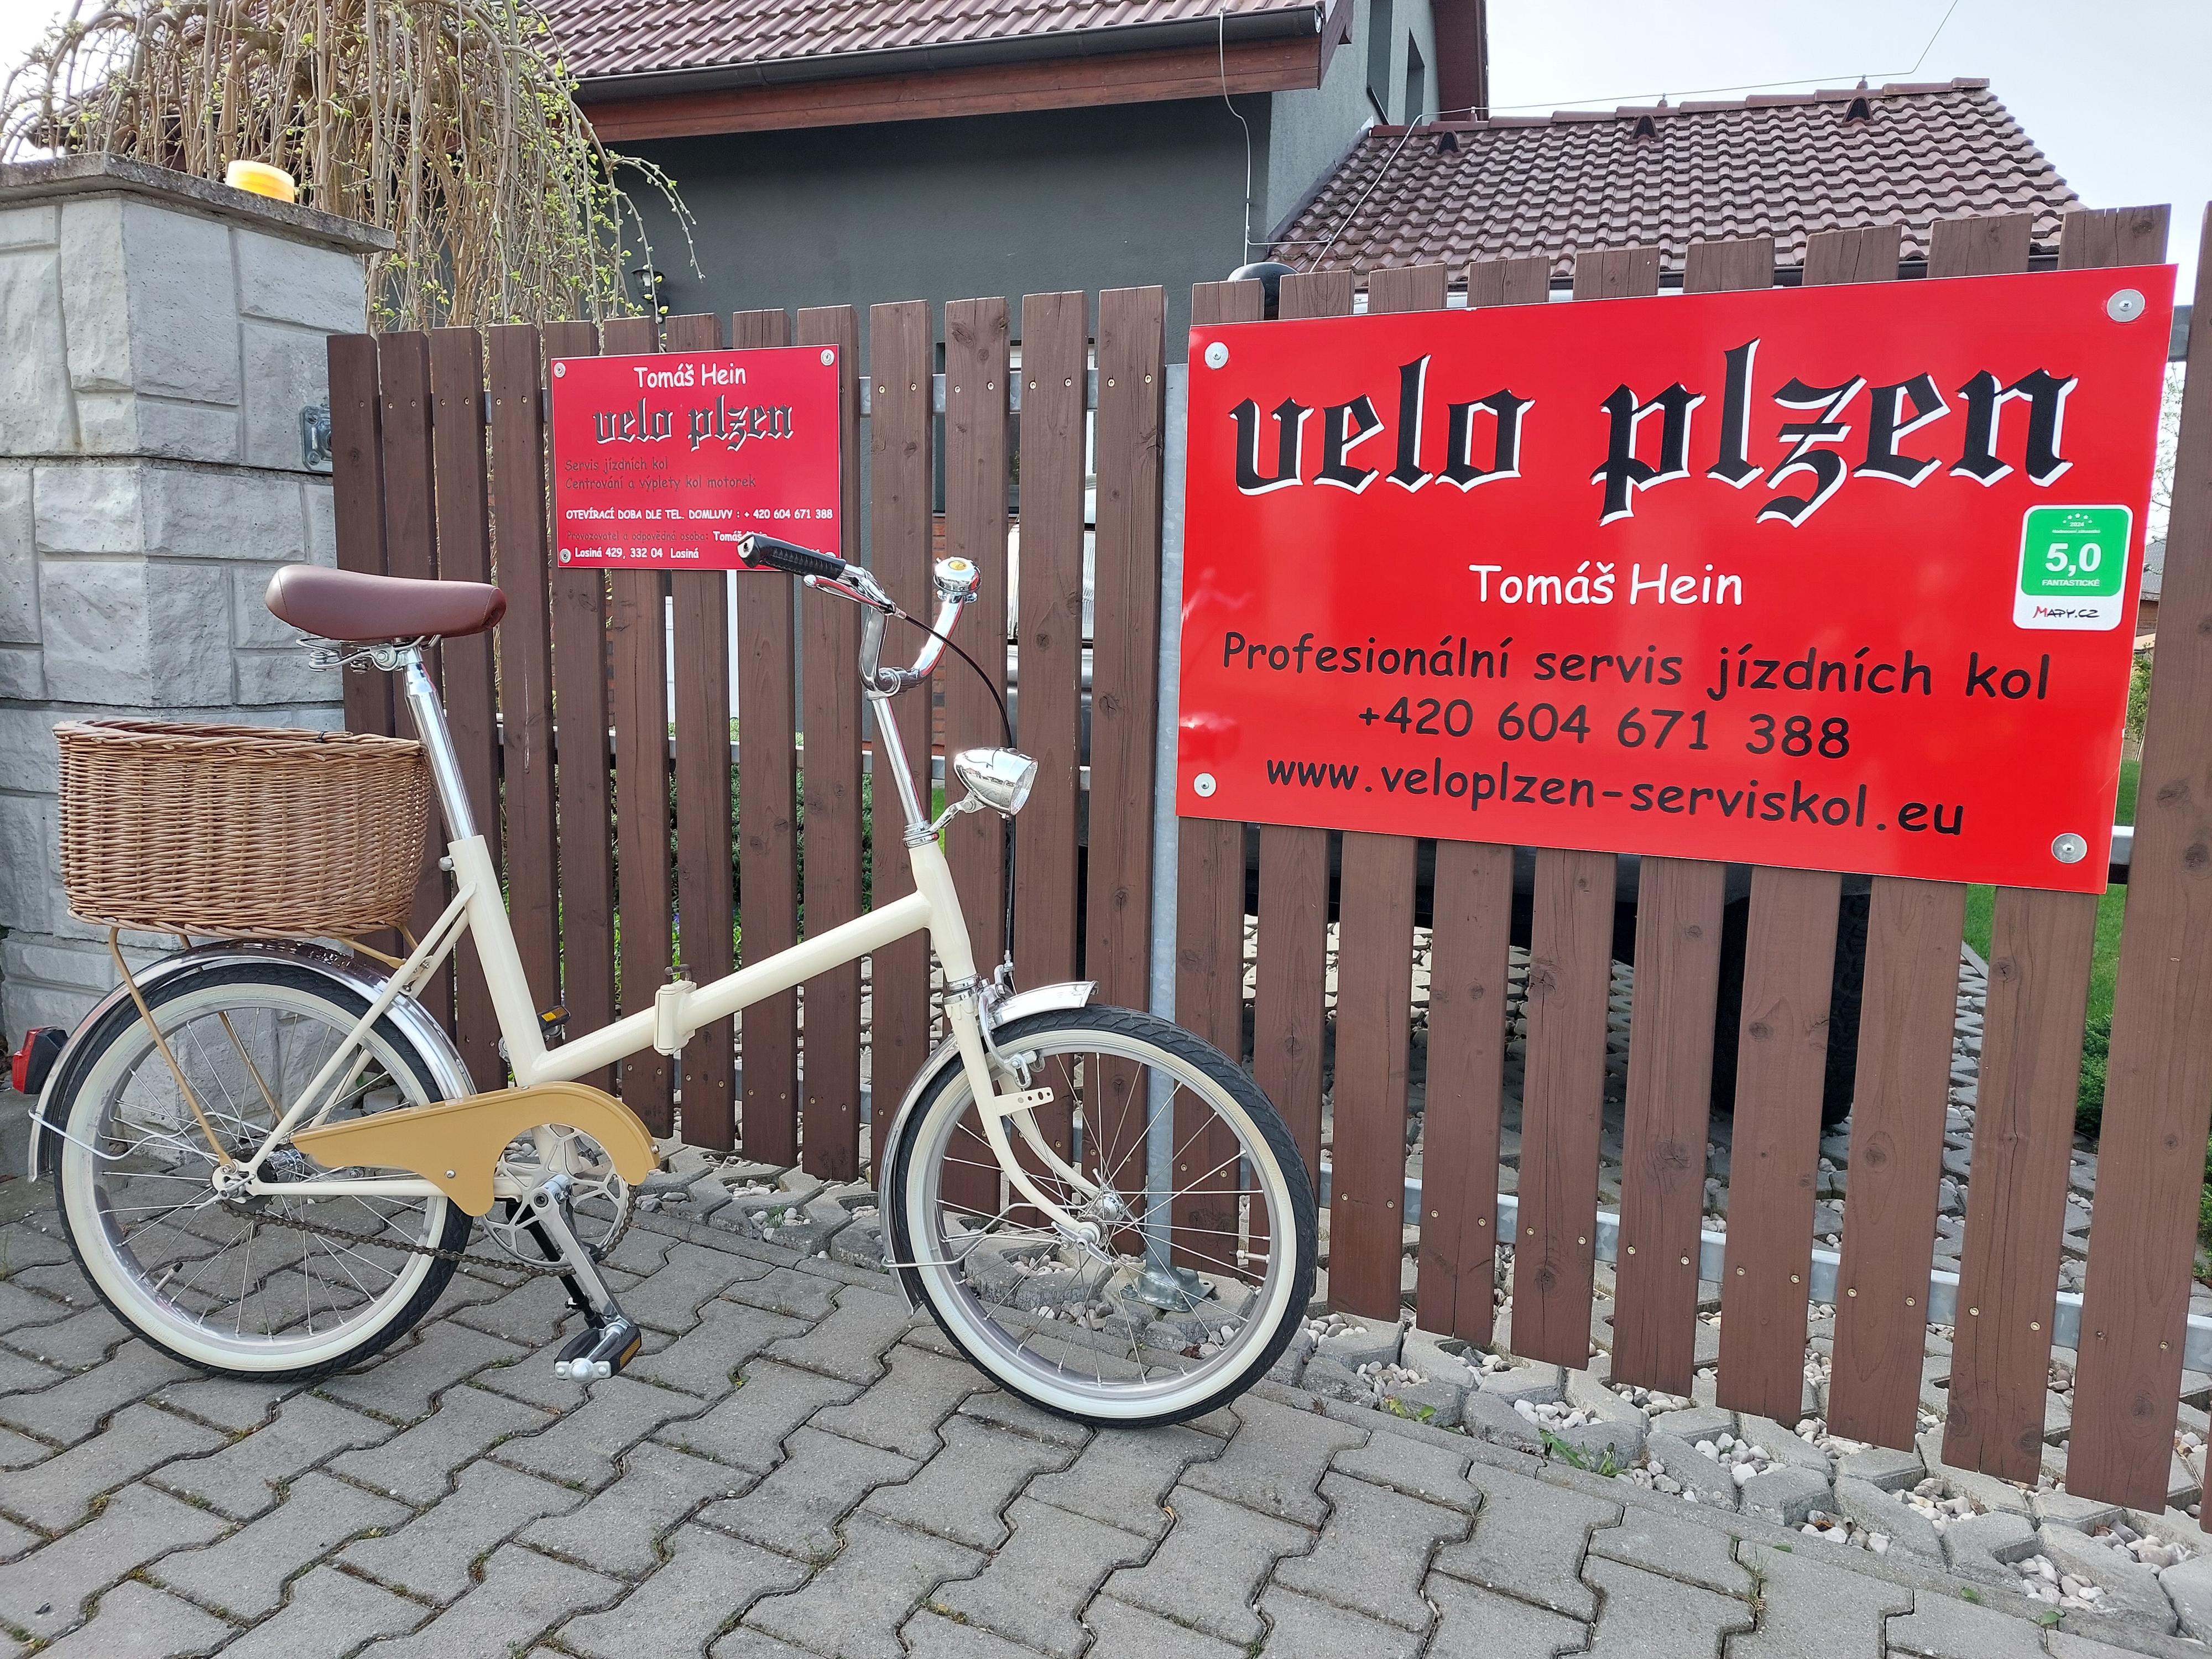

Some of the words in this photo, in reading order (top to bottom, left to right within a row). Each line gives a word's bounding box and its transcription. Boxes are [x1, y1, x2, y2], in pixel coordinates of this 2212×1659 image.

[633, 363, 695, 388] Tomáš
[701, 363, 746, 386] Hein
[593, 398, 673, 445] velo
[687, 394, 794, 452] plzen
[1227, 353, 1536, 497] velo
[1590, 337, 2074, 528] plzen
[565, 460, 599, 471] Servis
[603, 456, 647, 475] jízdních
[653, 457, 667, 469] kol
[565, 476, 623, 489] Centrování
[628, 480, 635, 489] a
[639, 475, 681, 492] výplety
[686, 475, 701, 488] kol
[707, 476, 756, 488] motorek
[566, 507, 615, 520] OTEVÍRACÍ
[618, 509, 642, 519] DOBA
[645, 509, 662, 519] DLE
[664, 509, 685, 519] TEL.
[688, 509, 733, 519] DOMLUVY
[753, 509, 770, 519] 420
[774, 509, 791, 519] 604
[794, 509, 811, 519] 671
[815, 508, 833, 519] 388
[567, 530, 619, 540] Provozovatel
[575, 546, 602, 557] Losiná
[605, 547, 625, 559] 429,
[630, 547, 648, 558] 332
[650, 547, 663, 558] 04
[670, 547, 699, 559] Losiná
[2045, 542, 2101, 577] 5,0
[1469, 560, 1615, 606] Tomáš
[1630, 563, 1742, 605] Hein
[2042, 578, 2100, 587] FANTASTICKÉ
[1223, 632, 1514, 679] Profesionální
[1533, 644, 1682, 685] servis
[1706, 643, 1932, 702] jízdních
[1965, 651, 2050, 700] kol
[1358, 696, 1473, 737] +420
[1498, 701, 1590, 744] 604
[1618, 707, 1708, 750] 671
[1745, 713, 1850, 759] 388
[1265, 755, 1964, 837] www.veloplzen-serviskol.eu
